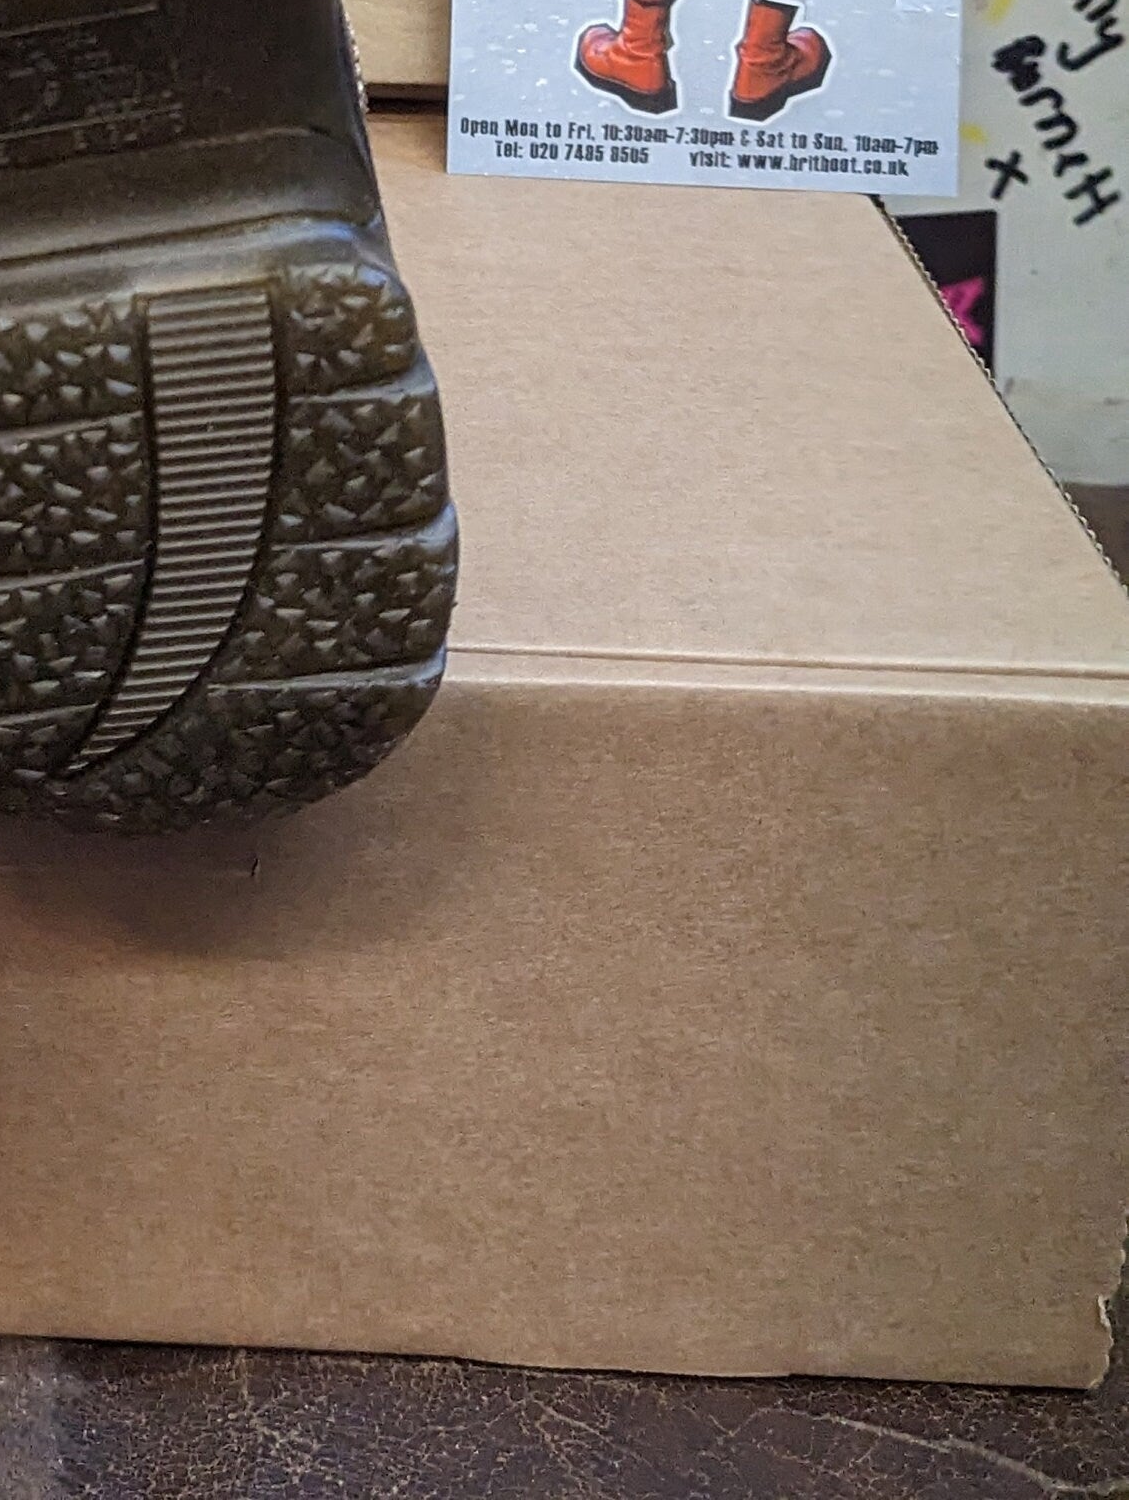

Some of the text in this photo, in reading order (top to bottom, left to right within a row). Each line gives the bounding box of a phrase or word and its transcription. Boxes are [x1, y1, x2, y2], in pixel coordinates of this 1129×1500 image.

[460, 117, 499, 138] Open
[505, 119, 538, 138] Mon
[546, 120, 562, 139] to
[755, 130, 785, 149] Sat
[790, 132, 808, 150] to
[854, 135, 939, 158] 10am-7pm
[495, 140, 523, 159] Tel:
[530, 142, 559, 160] 020
[564, 143, 604, 162] 7485
[690, 152, 731, 169] visit:
